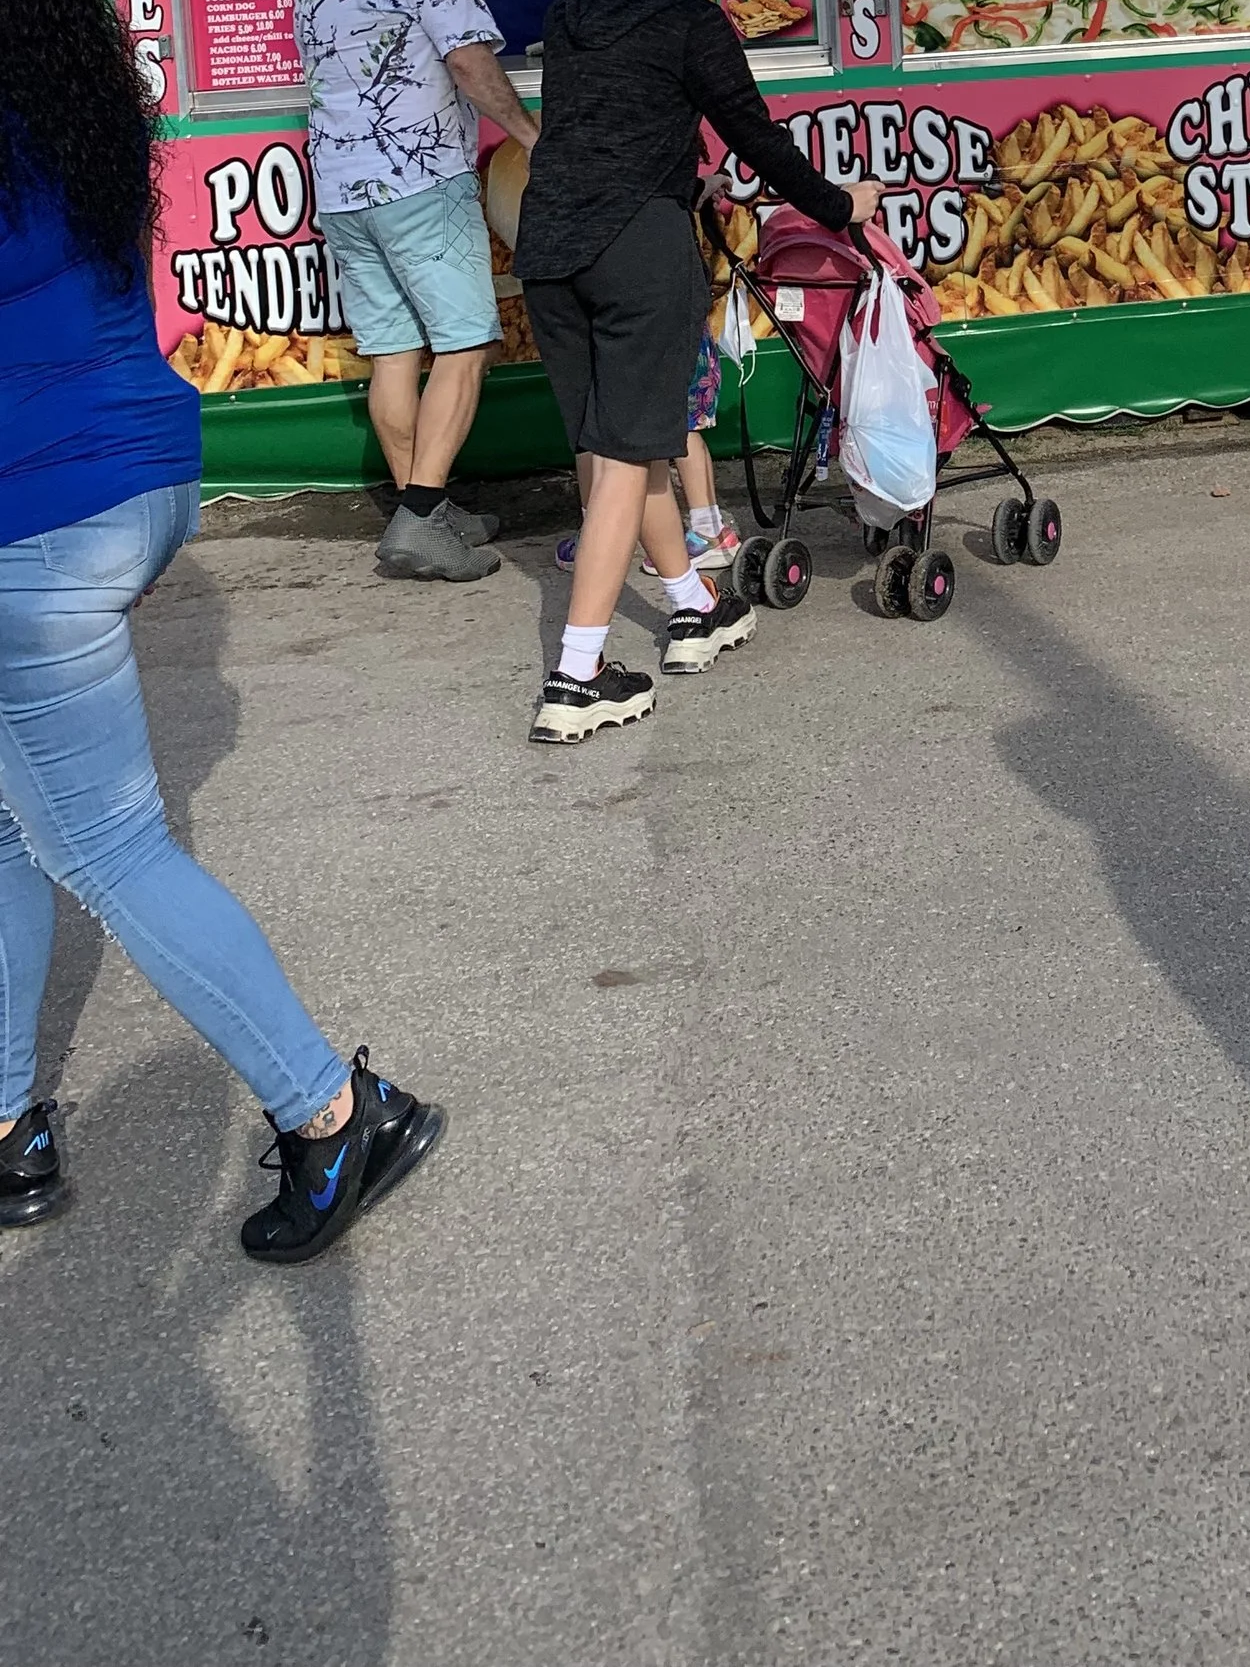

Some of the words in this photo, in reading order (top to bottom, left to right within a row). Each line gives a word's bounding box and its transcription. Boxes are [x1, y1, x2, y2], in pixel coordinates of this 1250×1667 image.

[206, 3, 234, 12] CORN
[235, 2, 256, 10] DOG
[207, 12, 268, 23] HAMBURGER
[268, 10, 285, 20] 6.00
[208, 25, 236, 34] FRIES
[213, 35, 230, 44] add
[210, 45, 249, 54] NACHOS
[250, 43, 267, 53] 6.00
[210, 55, 263, 65] LEMONADE
[265, 52, 281, 62] 7.00
[211, 67, 236, 76] SOFT
[237, 65, 274, 74] DRINKS
[212, 76, 255, 86] BOTTLED
[256, 74, 290, 84] WATER
[292, 72, 304, 83] 3.0
[207, 141, 318, 242] PO
